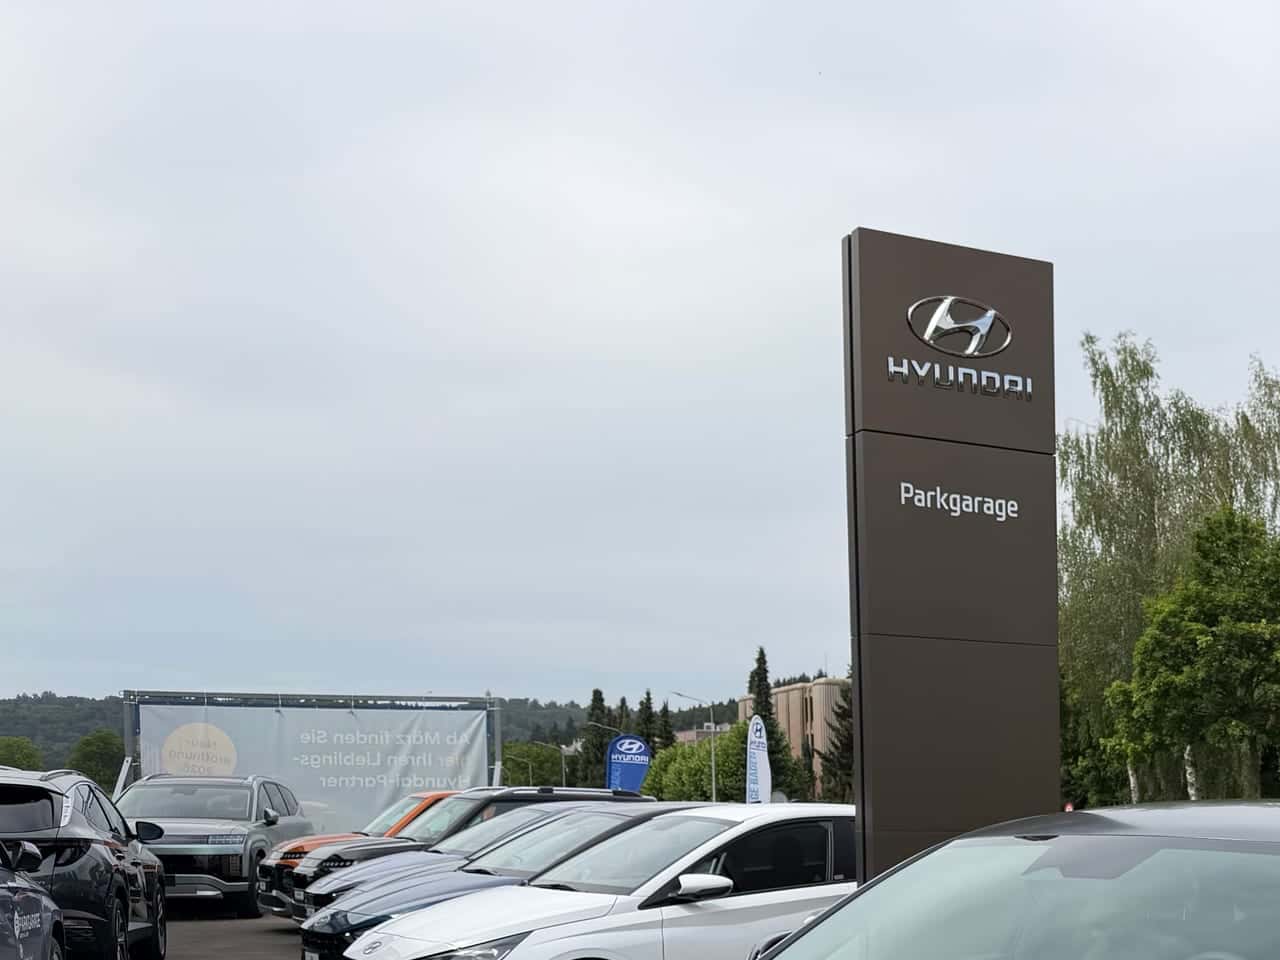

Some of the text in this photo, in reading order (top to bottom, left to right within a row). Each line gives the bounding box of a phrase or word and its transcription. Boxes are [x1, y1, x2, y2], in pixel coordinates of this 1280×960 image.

[887, 356, 1033, 400] HYUNDAI
[900, 482, 1019, 521] Parkgarage
[611, 753, 649, 763] HYUNDAI
